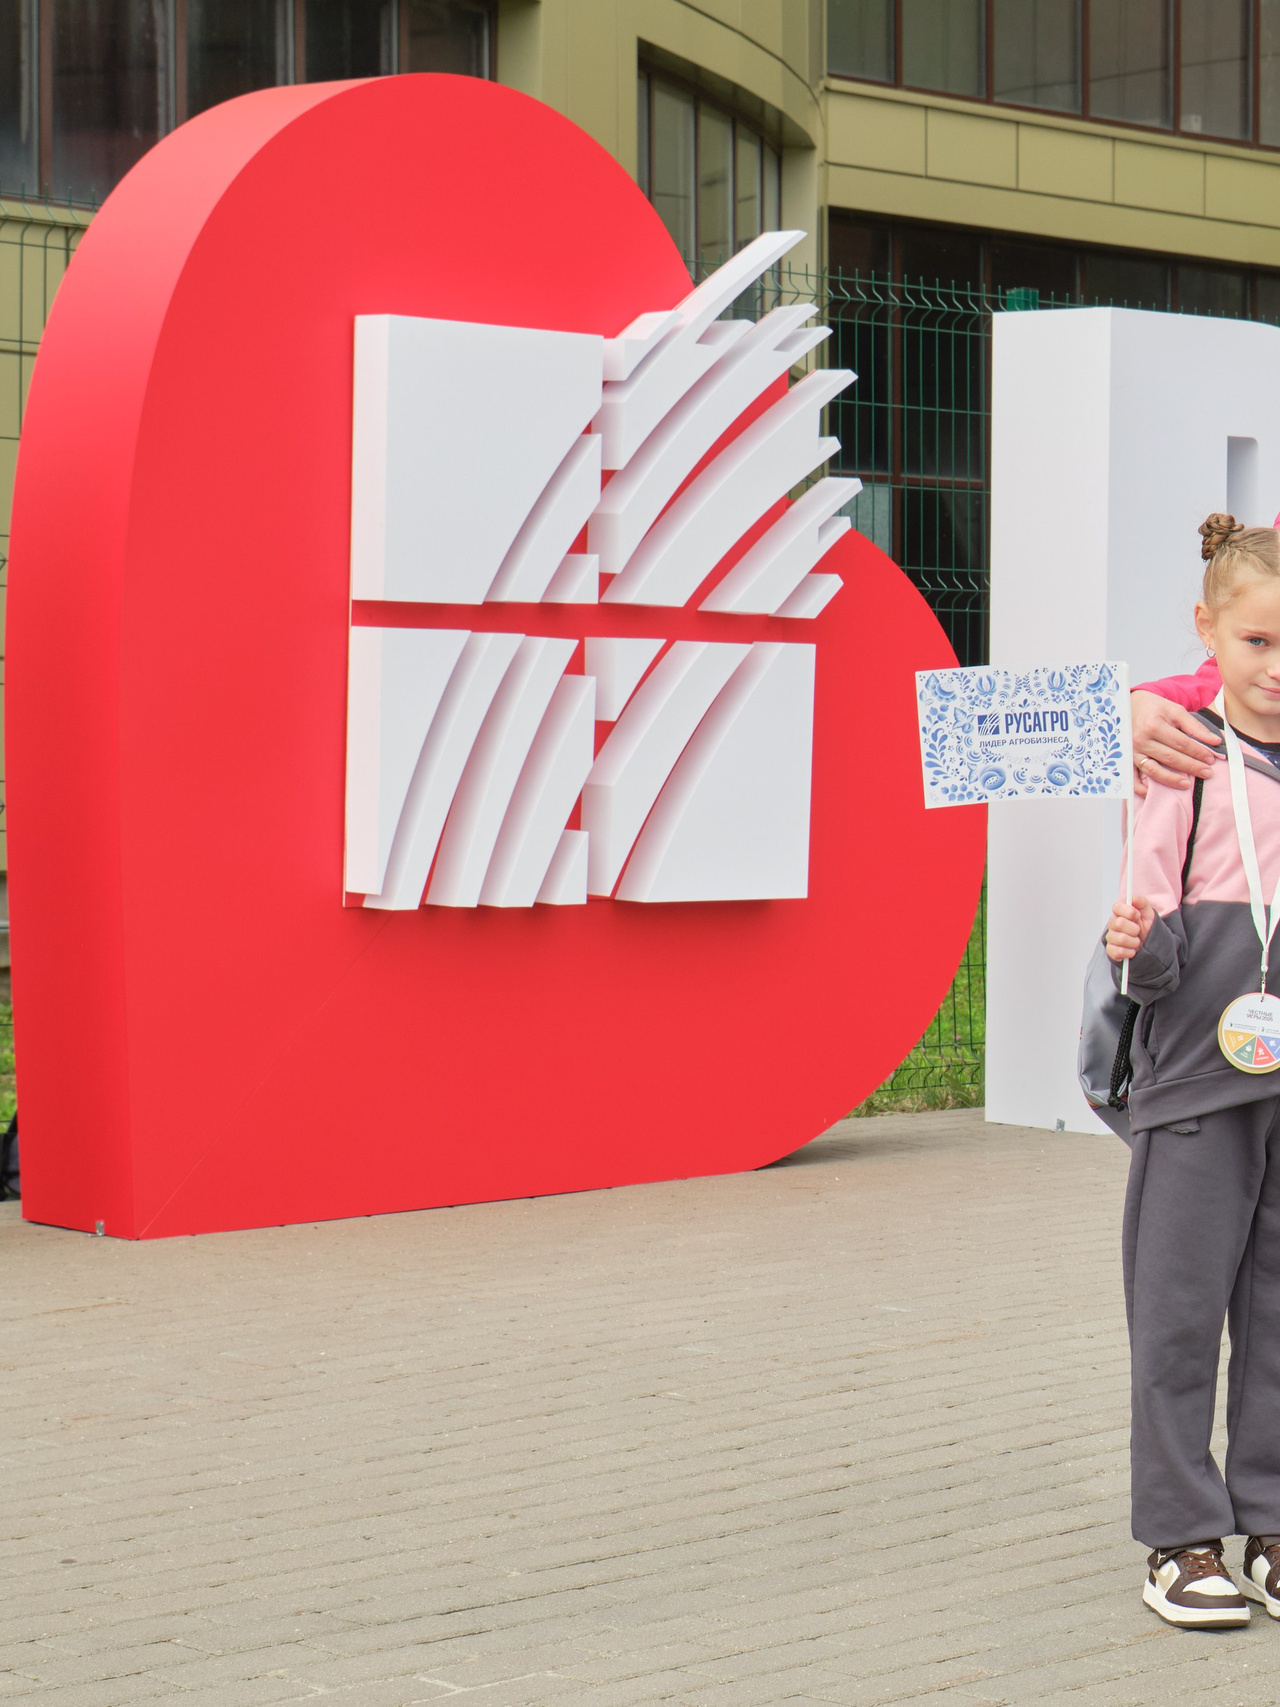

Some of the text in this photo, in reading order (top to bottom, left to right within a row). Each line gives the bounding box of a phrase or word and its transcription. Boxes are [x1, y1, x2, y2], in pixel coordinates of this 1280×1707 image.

[1004, 710, 1069, 734] РУСАГРО
[979, 736, 1070, 748] ЛИДЕР АГРОБИЗНЕСА
